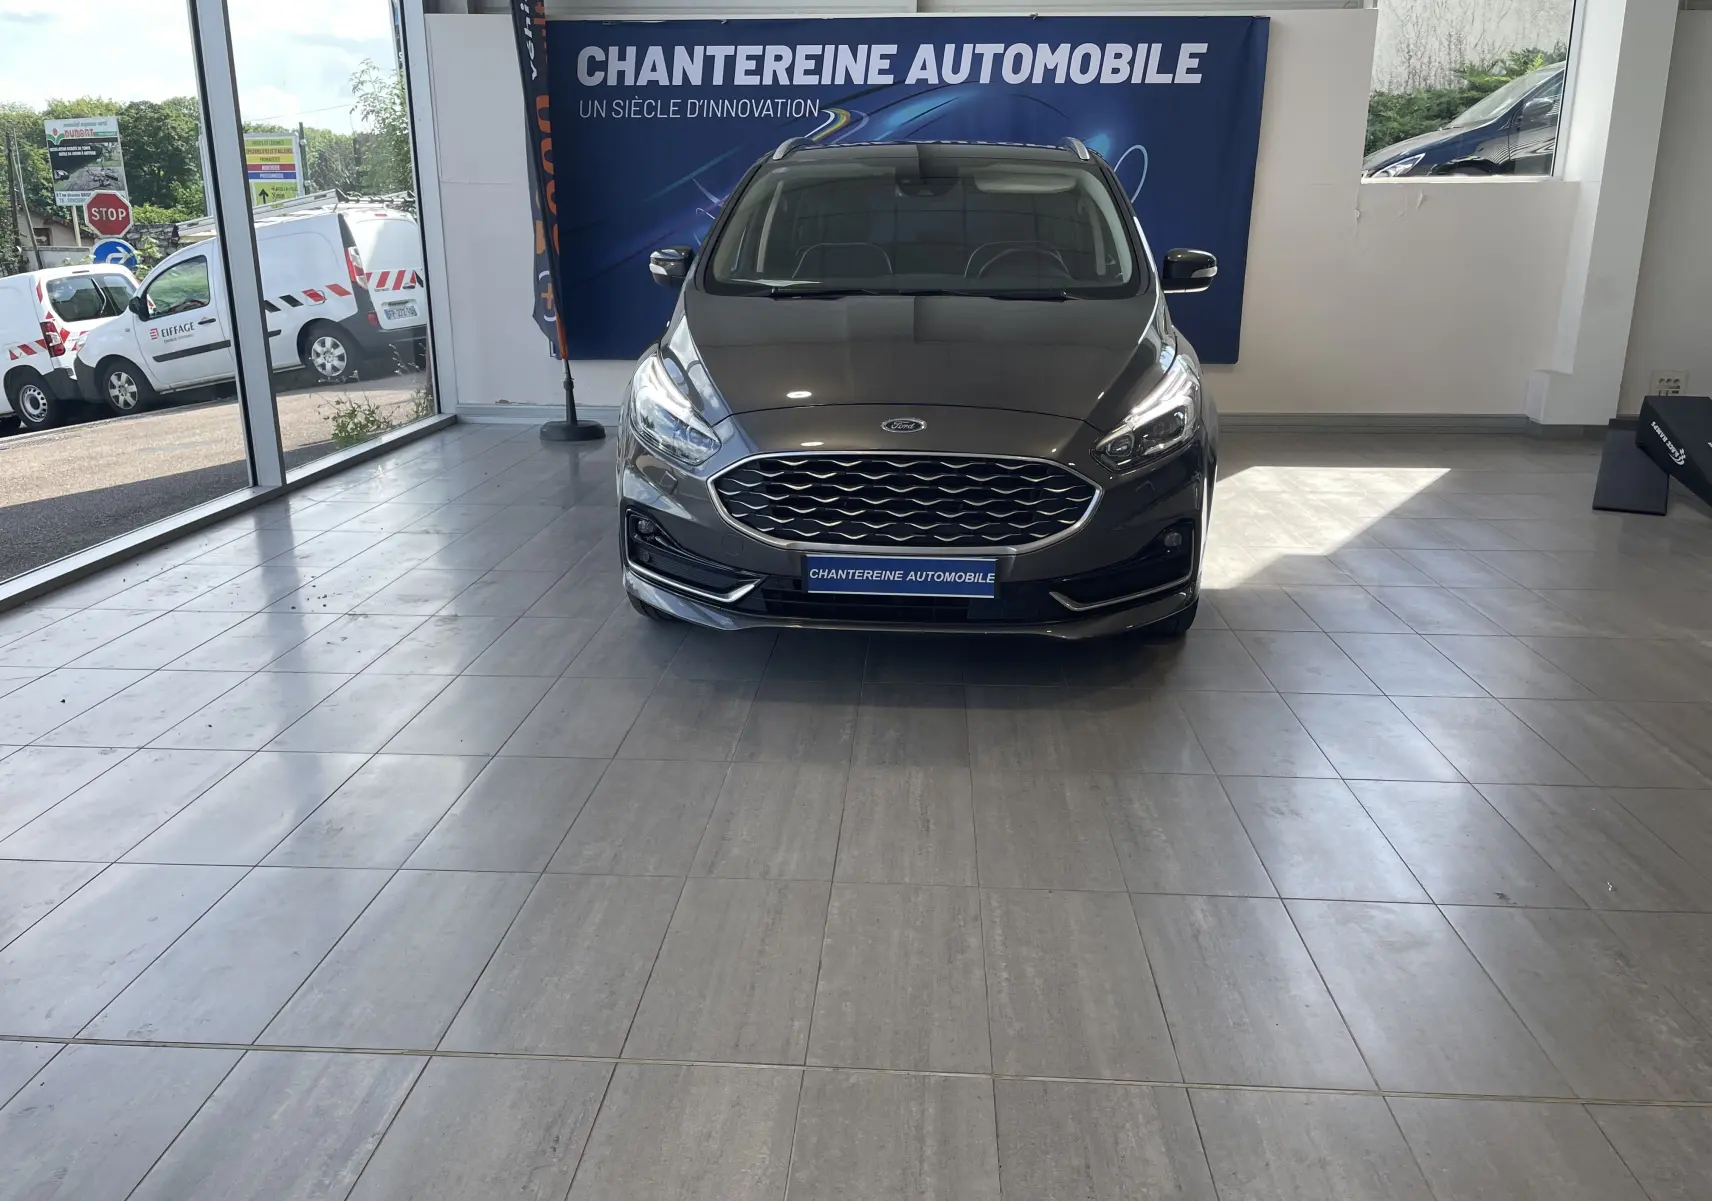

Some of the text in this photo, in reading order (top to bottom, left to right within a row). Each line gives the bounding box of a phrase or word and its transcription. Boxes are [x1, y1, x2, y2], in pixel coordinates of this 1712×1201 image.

[576, 42, 1208, 86] CHANTEREINE AUTOMOBILE
[579, 95, 820, 118] UN SIÈCLE D'INNOVATION
[91, 207, 127, 221] STOP
[161, 322, 195, 338] EIFFAGE
[890, 419, 916, 431] Ford
[809, 568, 995, 584] CHANTEREINE AUTOMOBILE
